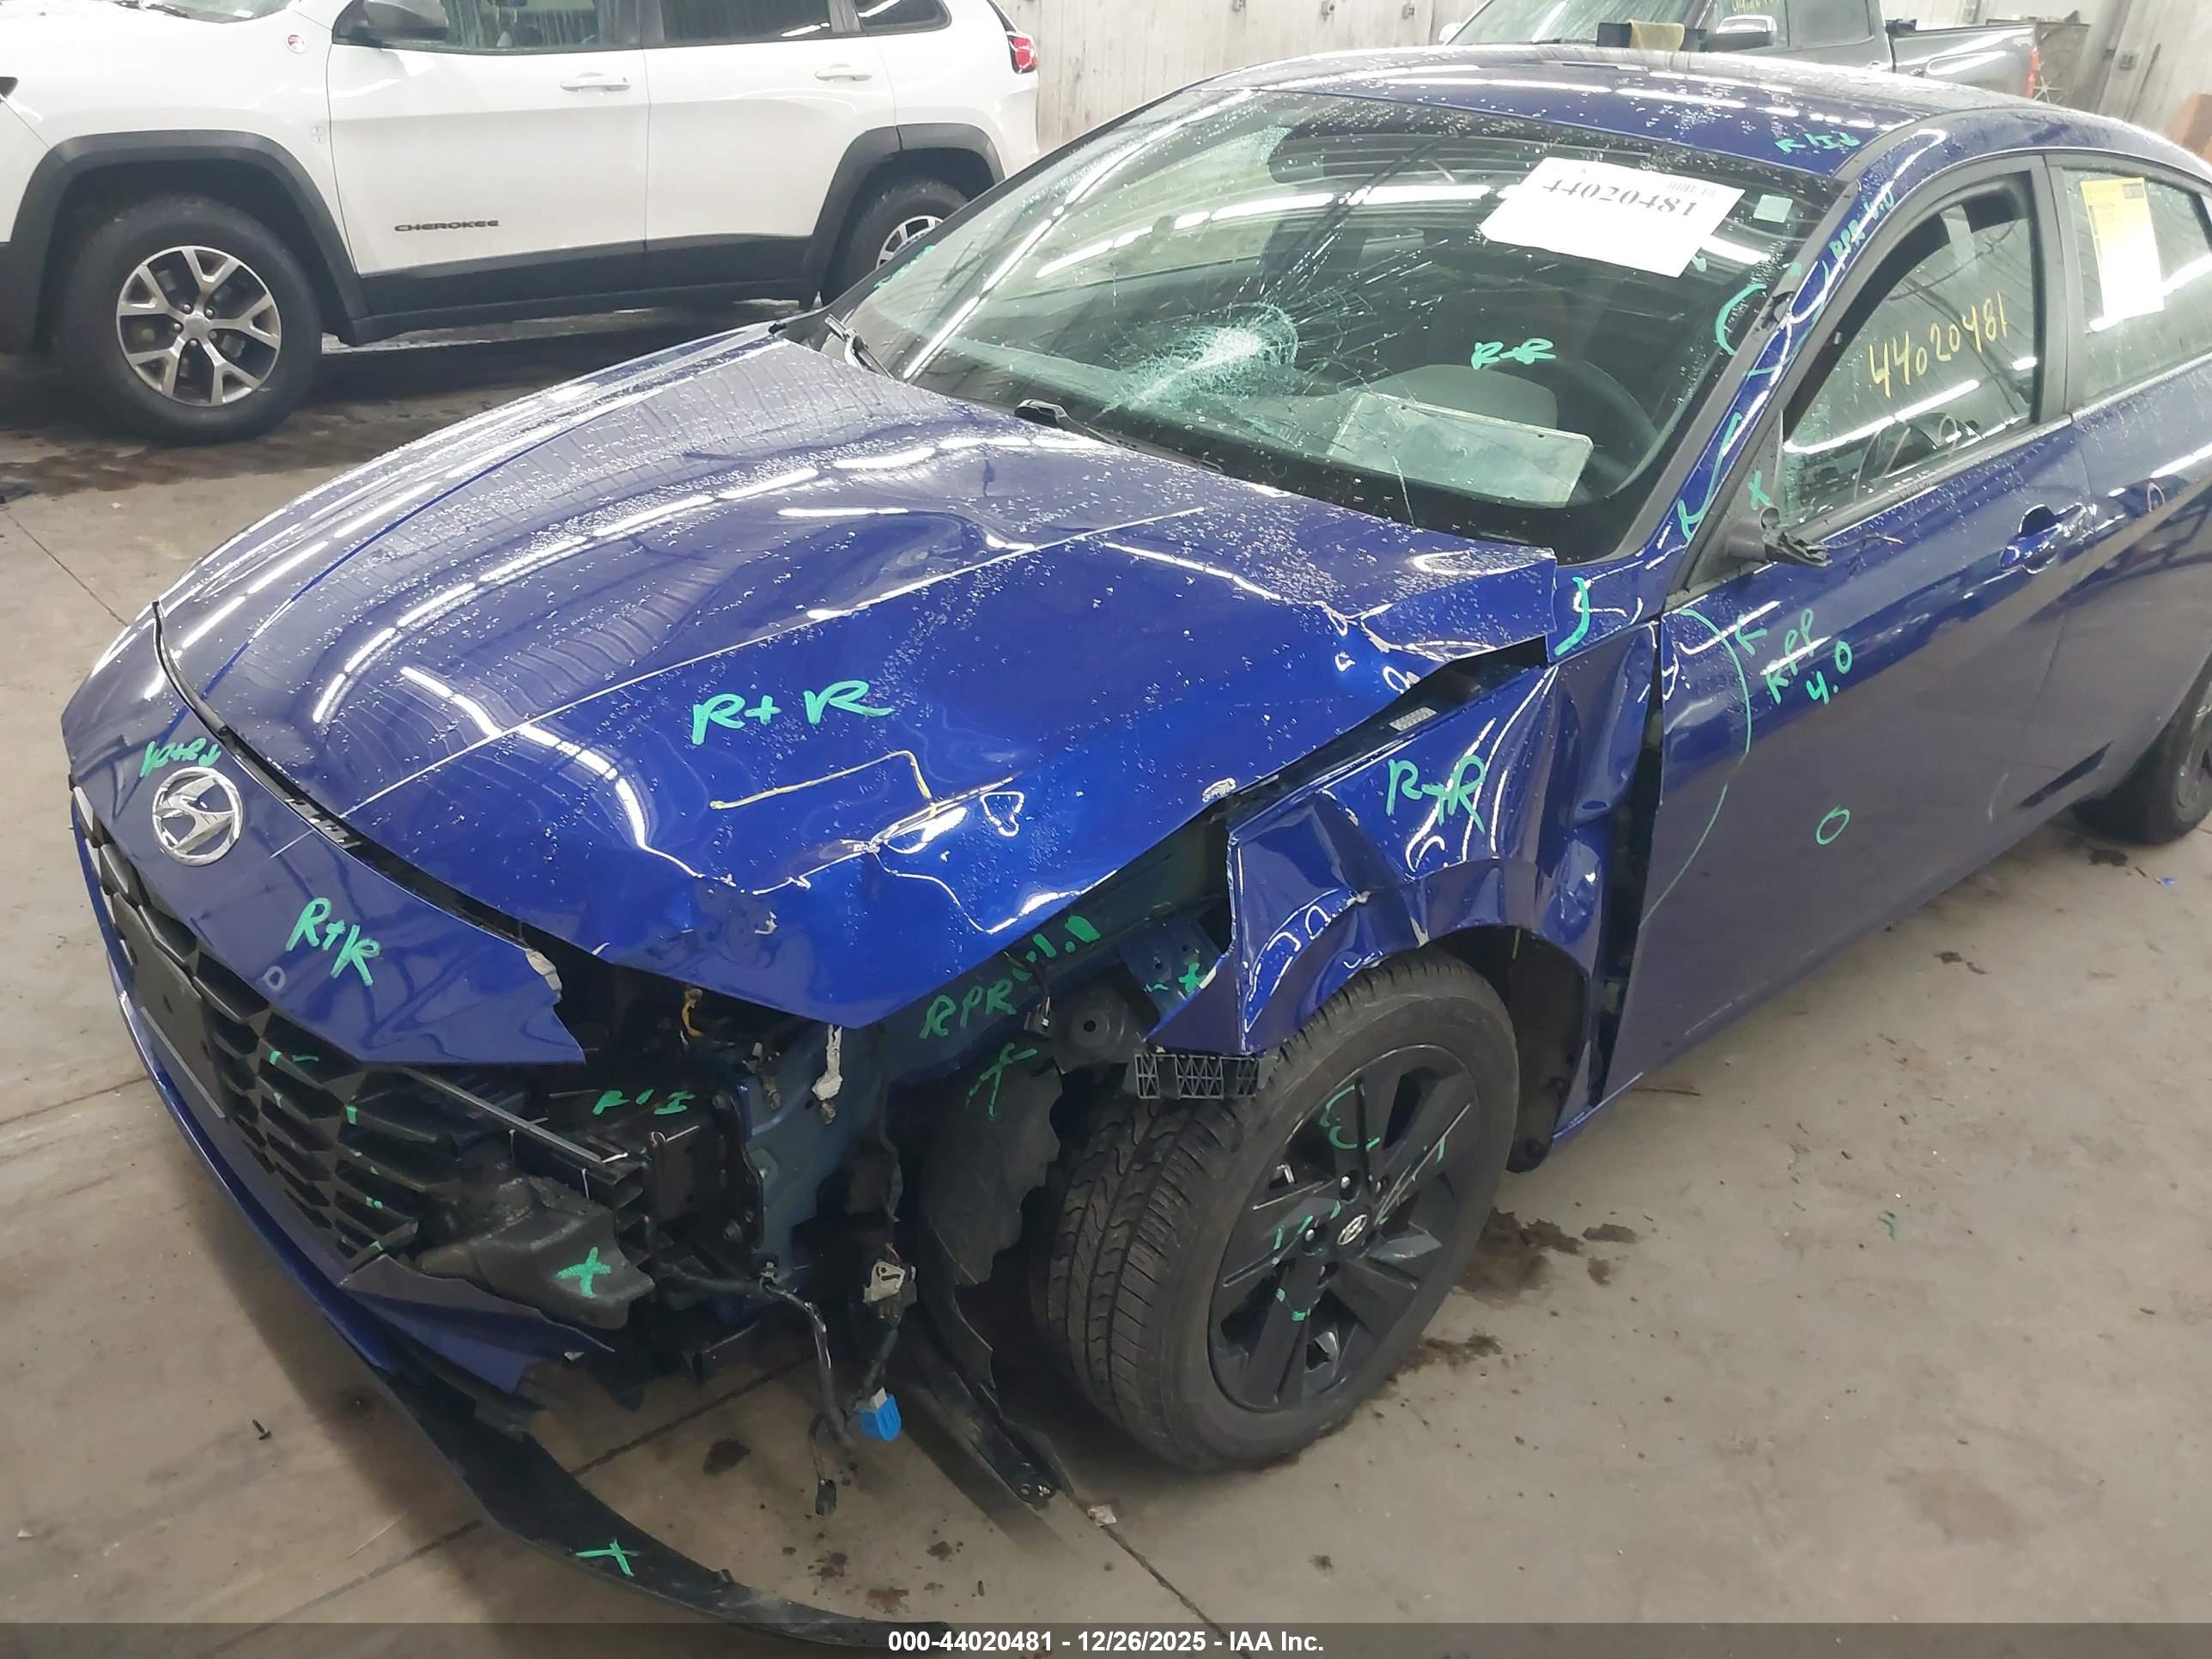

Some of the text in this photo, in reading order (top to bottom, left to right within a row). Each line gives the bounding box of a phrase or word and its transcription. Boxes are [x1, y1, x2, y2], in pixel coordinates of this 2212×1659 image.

[1542, 179, 1698, 216] 44020481
[394, 220, 499, 232] CHEROKEE
[1869, 289, 2008, 398] 44020481
